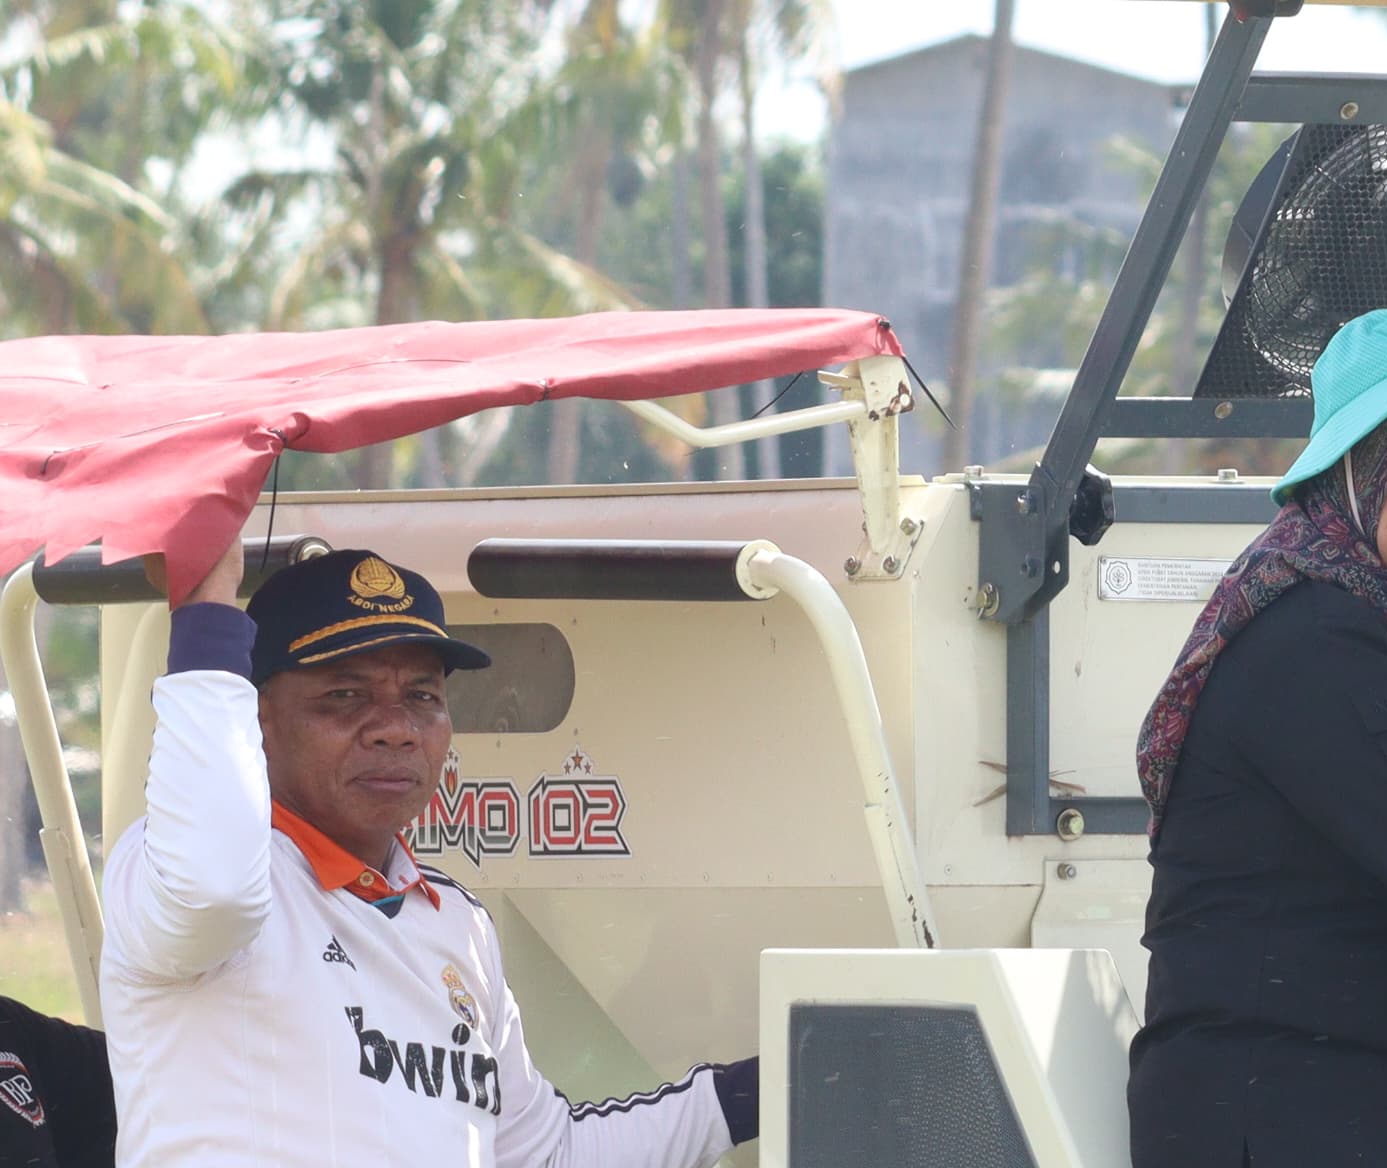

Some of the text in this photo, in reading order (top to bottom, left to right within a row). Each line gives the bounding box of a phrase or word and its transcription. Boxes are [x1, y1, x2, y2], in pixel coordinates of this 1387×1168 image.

[401, 777, 631, 866] IMO 102
[344, 1006, 501, 1116] bwin
